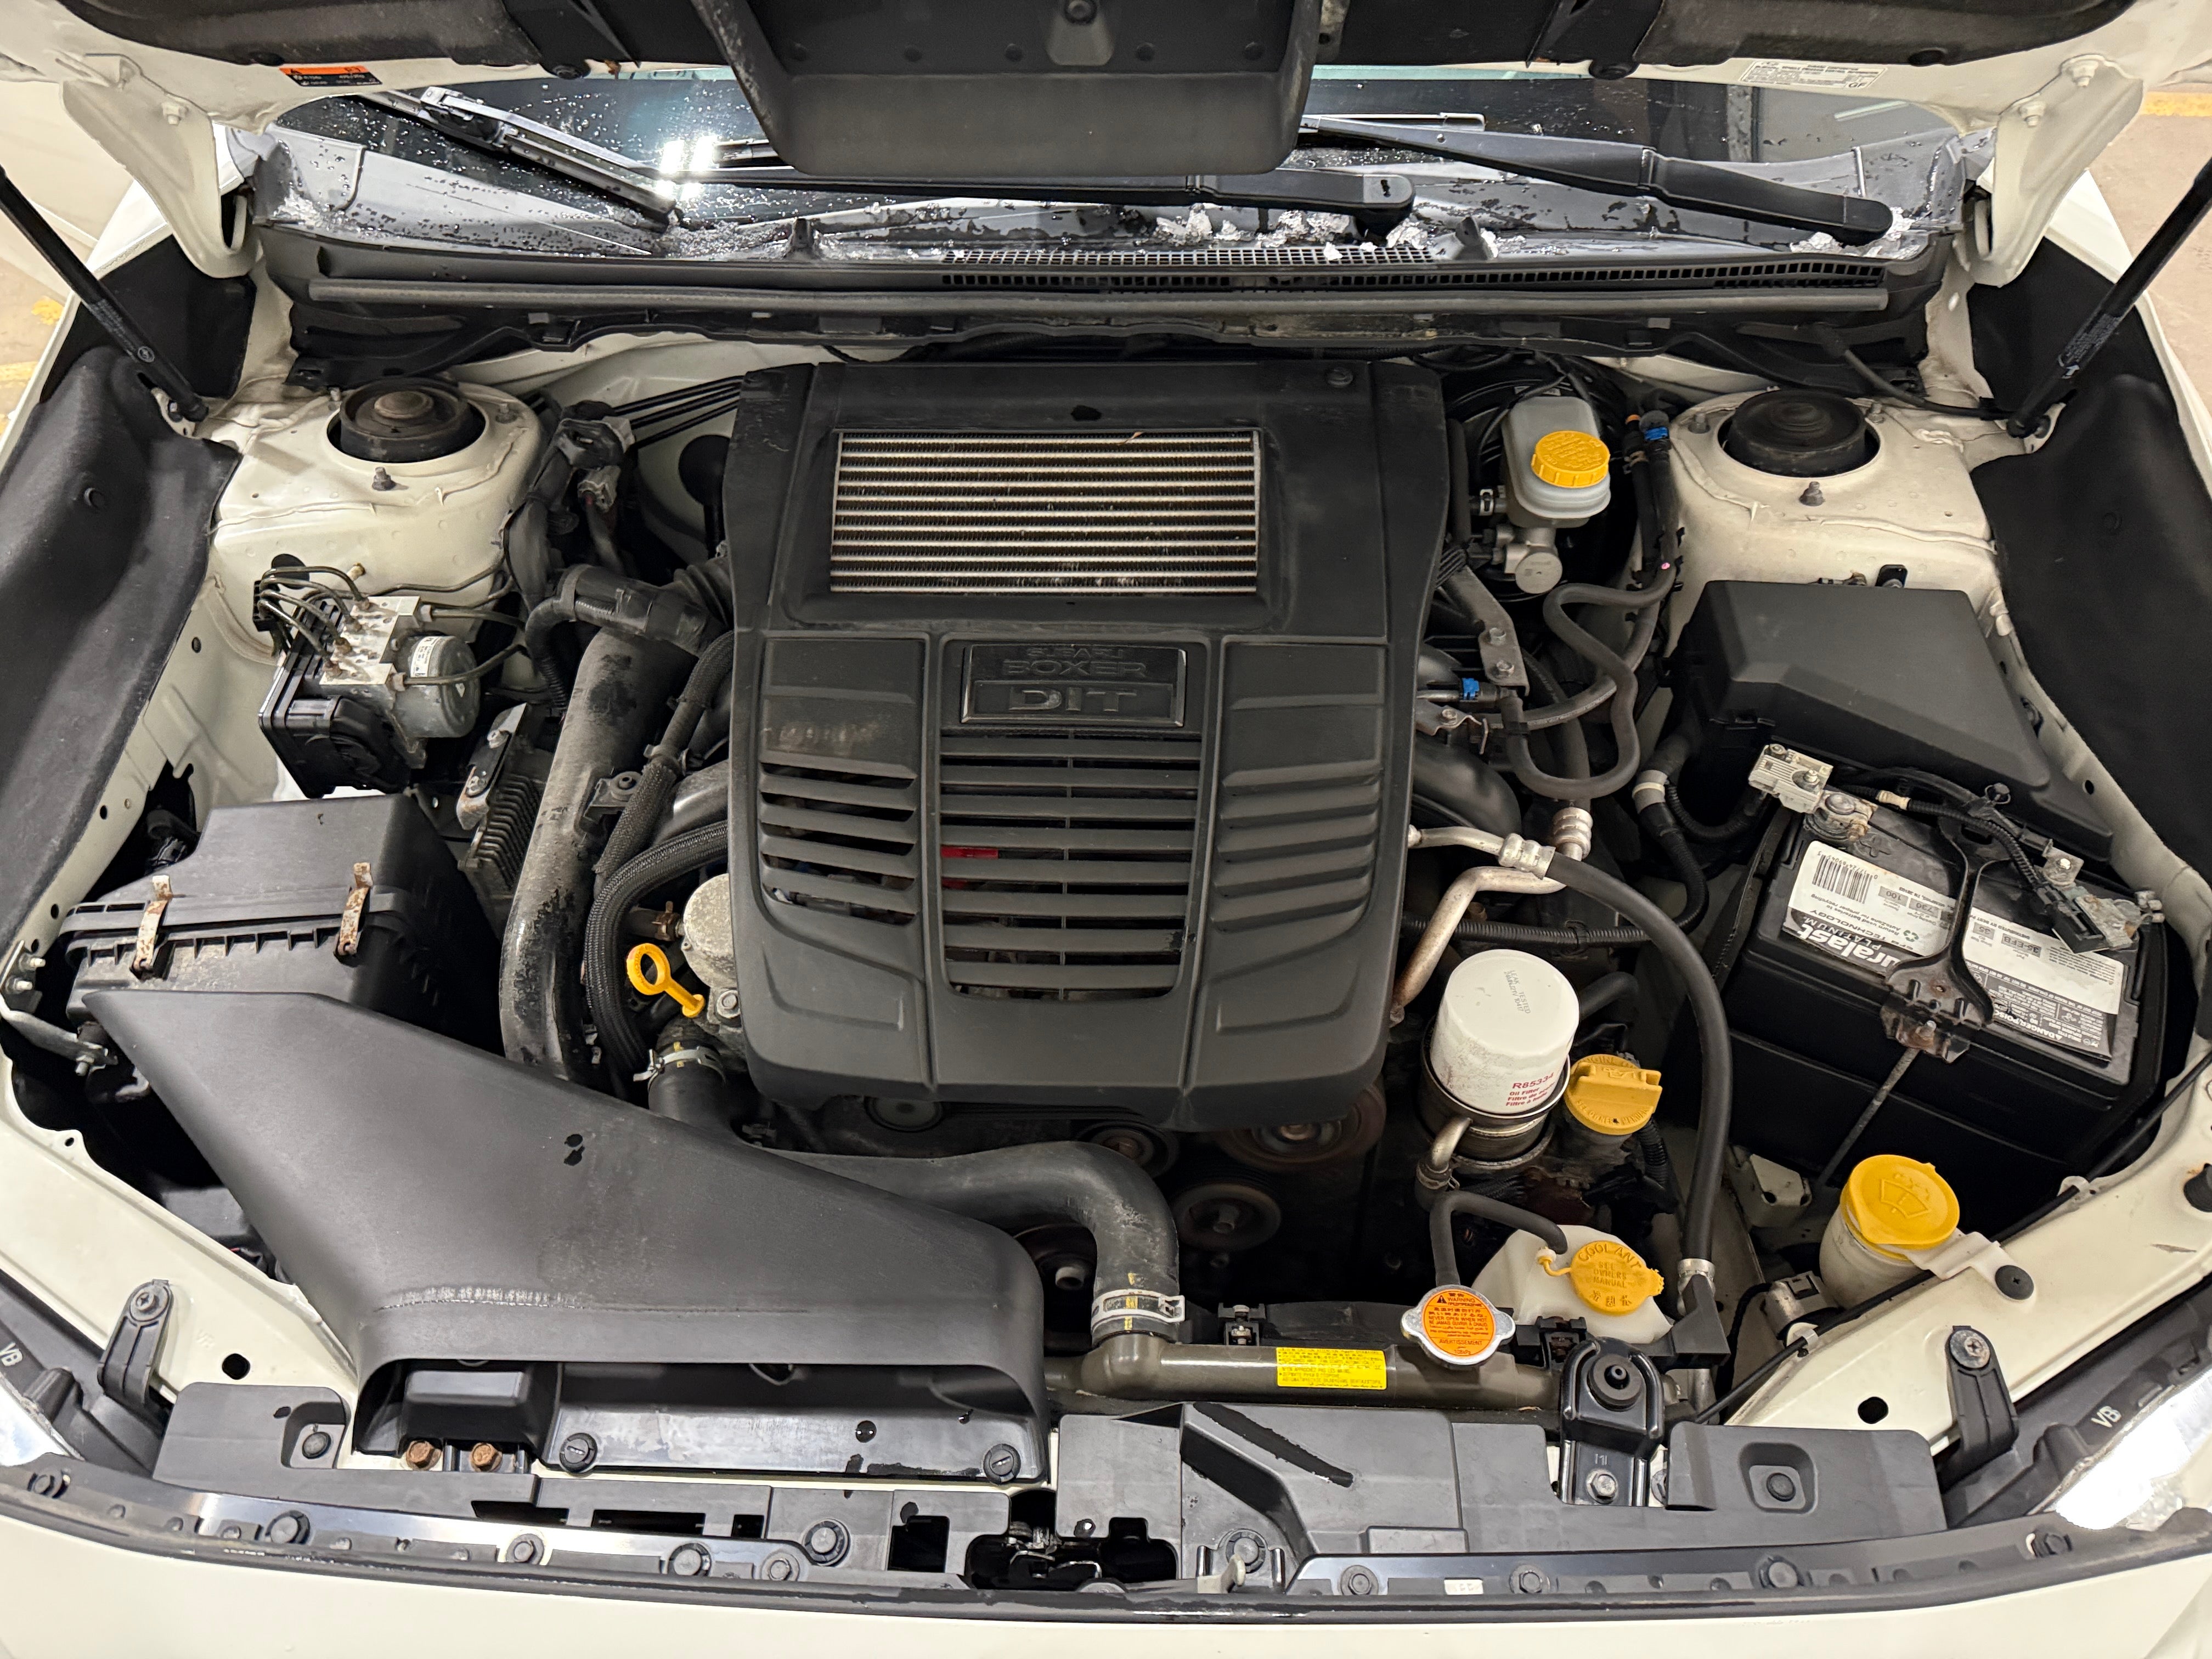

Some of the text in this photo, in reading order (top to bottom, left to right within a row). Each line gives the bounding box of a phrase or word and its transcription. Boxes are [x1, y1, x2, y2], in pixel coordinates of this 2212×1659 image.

[1003, 661, 1146, 678] BOXER
[1009, 687, 1137, 711] DIT
[1810, 892, 1838, 907] recycling
[1884, 890, 1902, 901] 100
[1833, 907, 1861, 921] batteries
[1839, 904, 1860, 915] proper
[1915, 901, 1933, 913] 730
[1810, 908, 1886, 940] TECHNOLOGY
[1861, 918, 1876, 927] used
[1870, 916, 1900, 932] AutoZone
[1877, 924, 1899, 935] Return
[1978, 926, 1991, 935] 35
[1805, 916, 1882, 951] PLATINUM
[1797, 923, 1902, 969] uralast
[2002, 935, 2039, 953] 35-EFB
[1510, 970, 1531, 1014] LEAK TESTED
[1993, 1009, 2056, 1038] DANGER/POISO
[1513, 1072, 1554, 1088] R85334
[1578, 1243, 1641, 1268] COOLANT
[1599, 1261, 1613, 1271] SEE
[1594, 1277, 1626, 1288] MANUAL
[2091, 1406, 2121, 1428] VB
